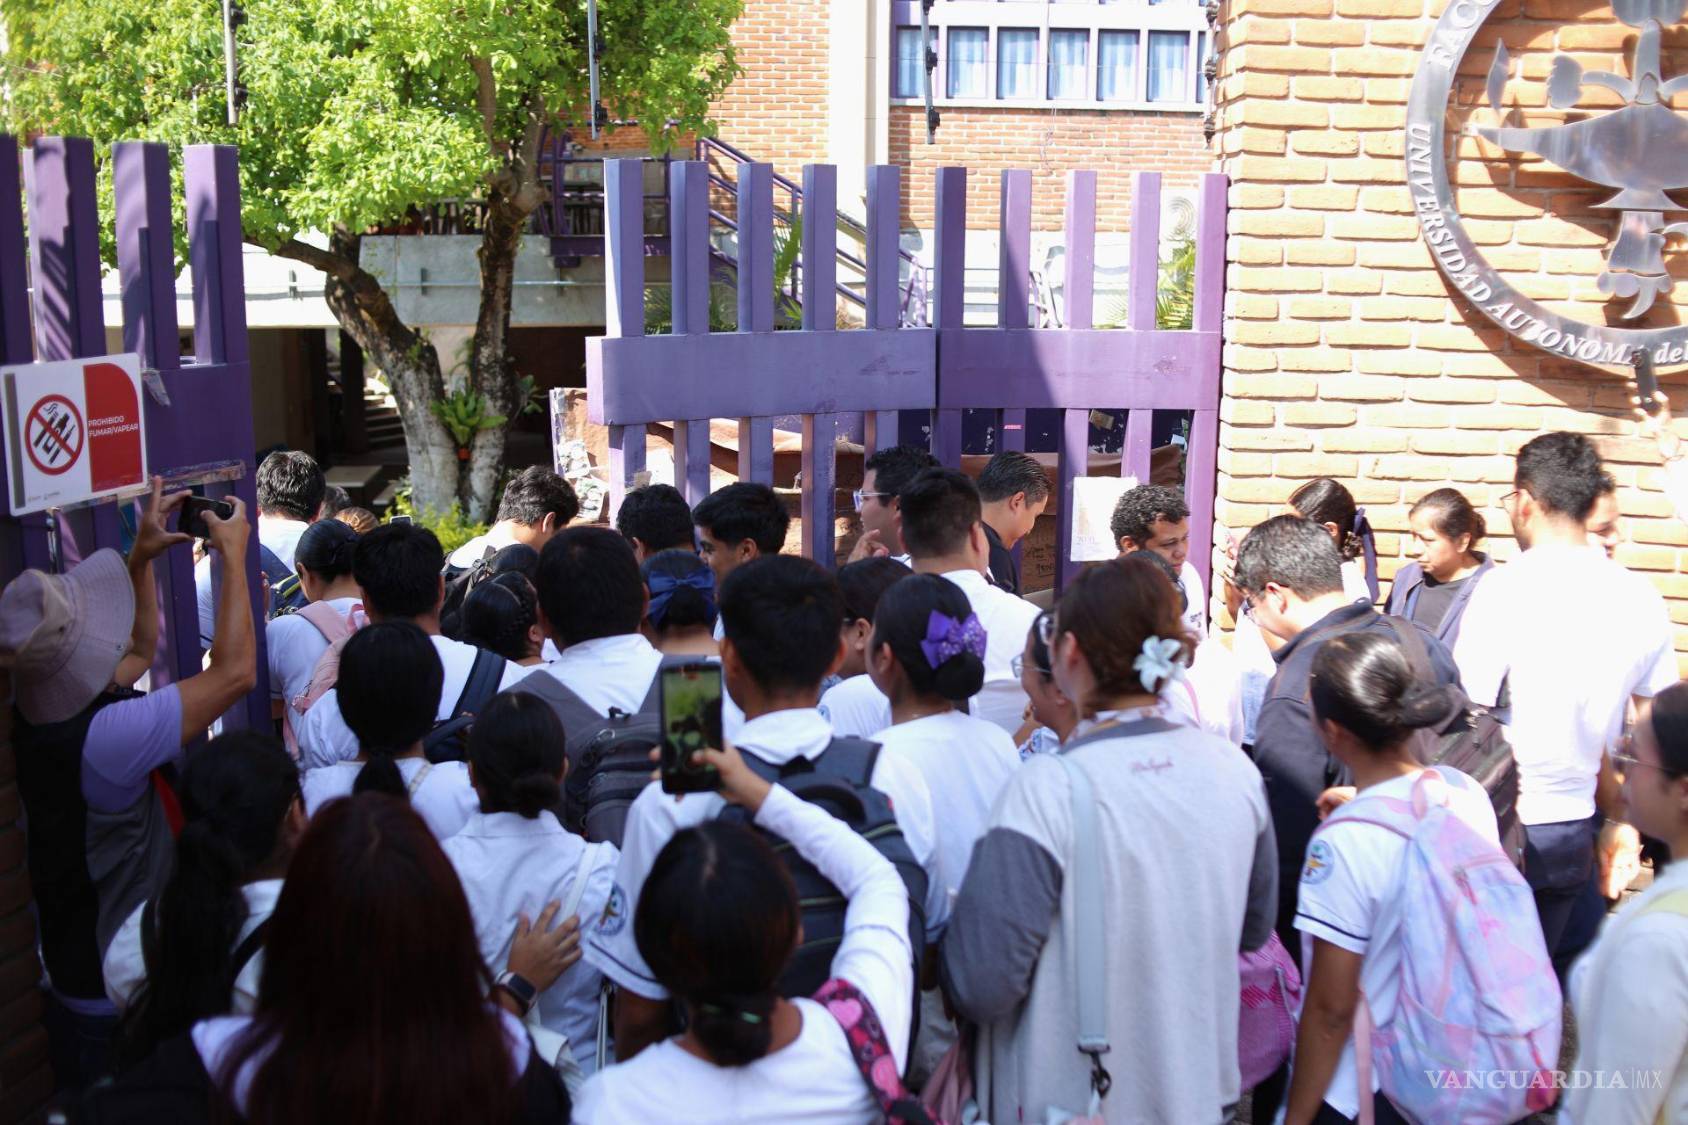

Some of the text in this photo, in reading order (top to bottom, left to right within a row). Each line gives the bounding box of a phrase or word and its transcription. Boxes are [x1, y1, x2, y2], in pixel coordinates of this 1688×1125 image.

[1407, 123, 1491, 302] UNIVERSIDAD
[1486, 303, 1646, 368] AUTONOM
[88, 416, 124, 426] PROHIBIDO
[88, 423, 139, 437] FUMAR/VAPEAR
